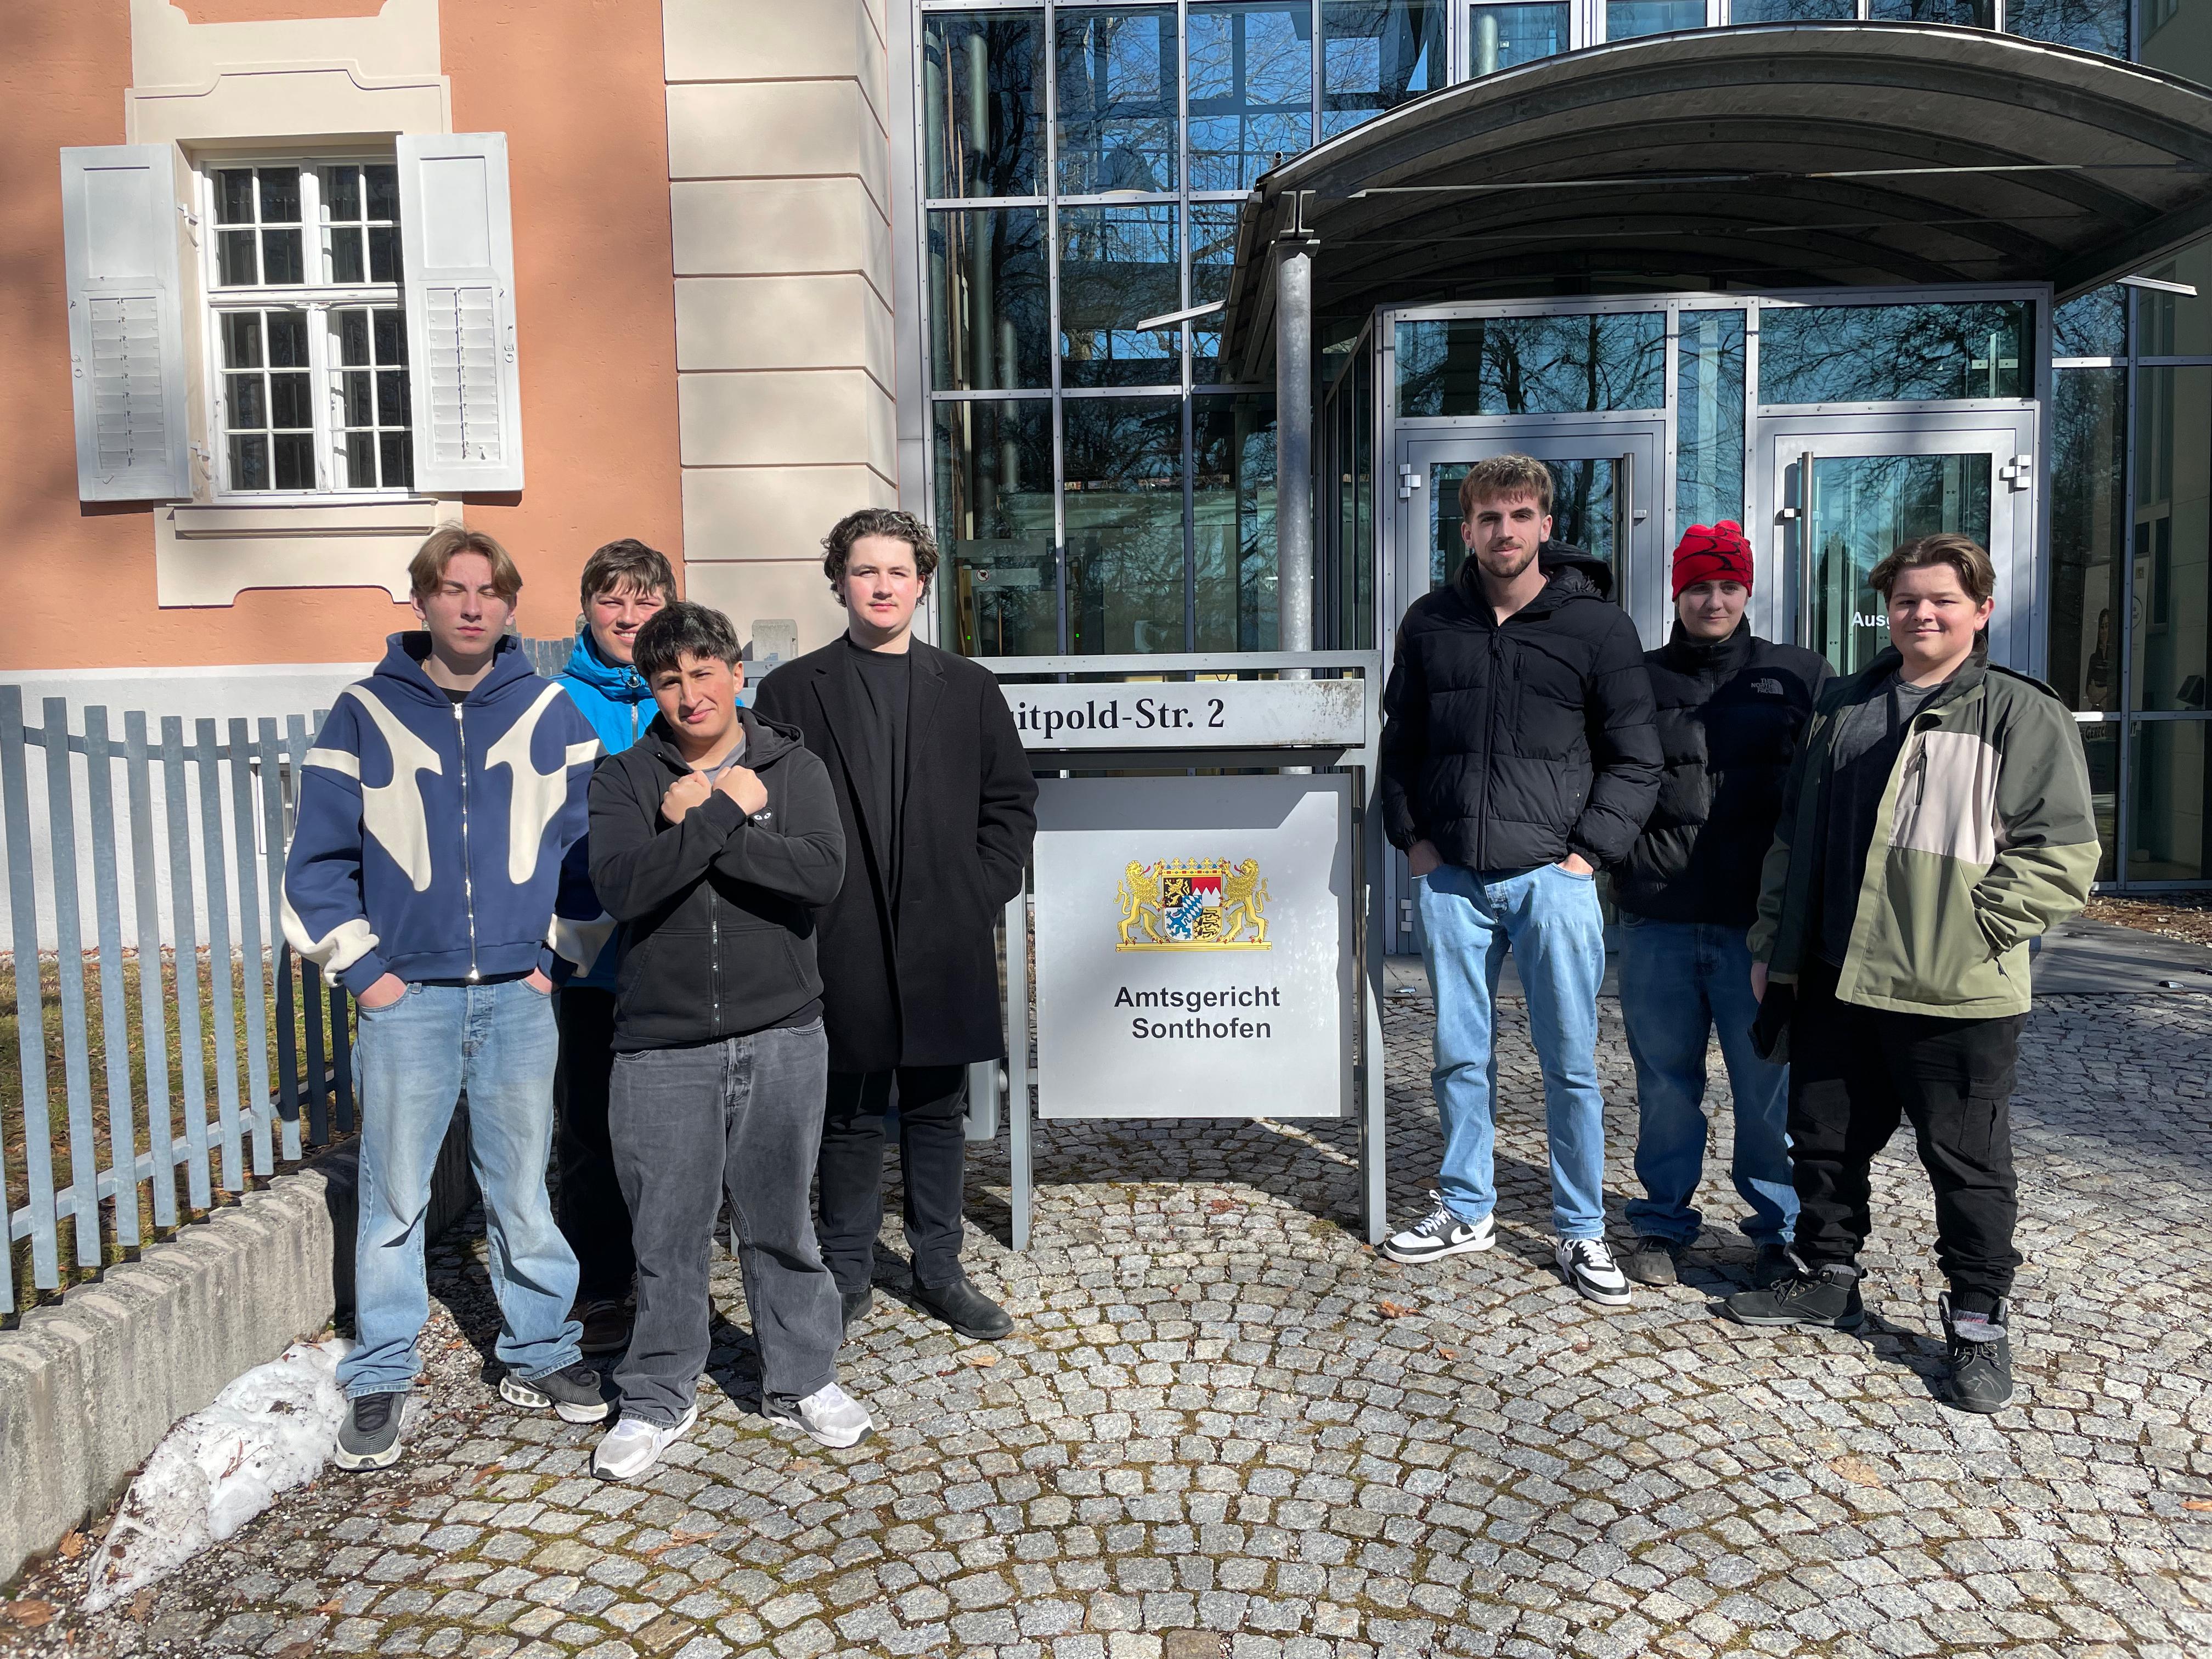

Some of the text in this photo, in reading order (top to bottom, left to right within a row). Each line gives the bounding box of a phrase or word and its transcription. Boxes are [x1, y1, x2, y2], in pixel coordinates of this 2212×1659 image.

[1011, 698, 1224, 739] itpold-Str. 2
[1114, 986, 1280, 1012] Amtsgericht
[1132, 1017, 1271, 1039] Sonthofen
